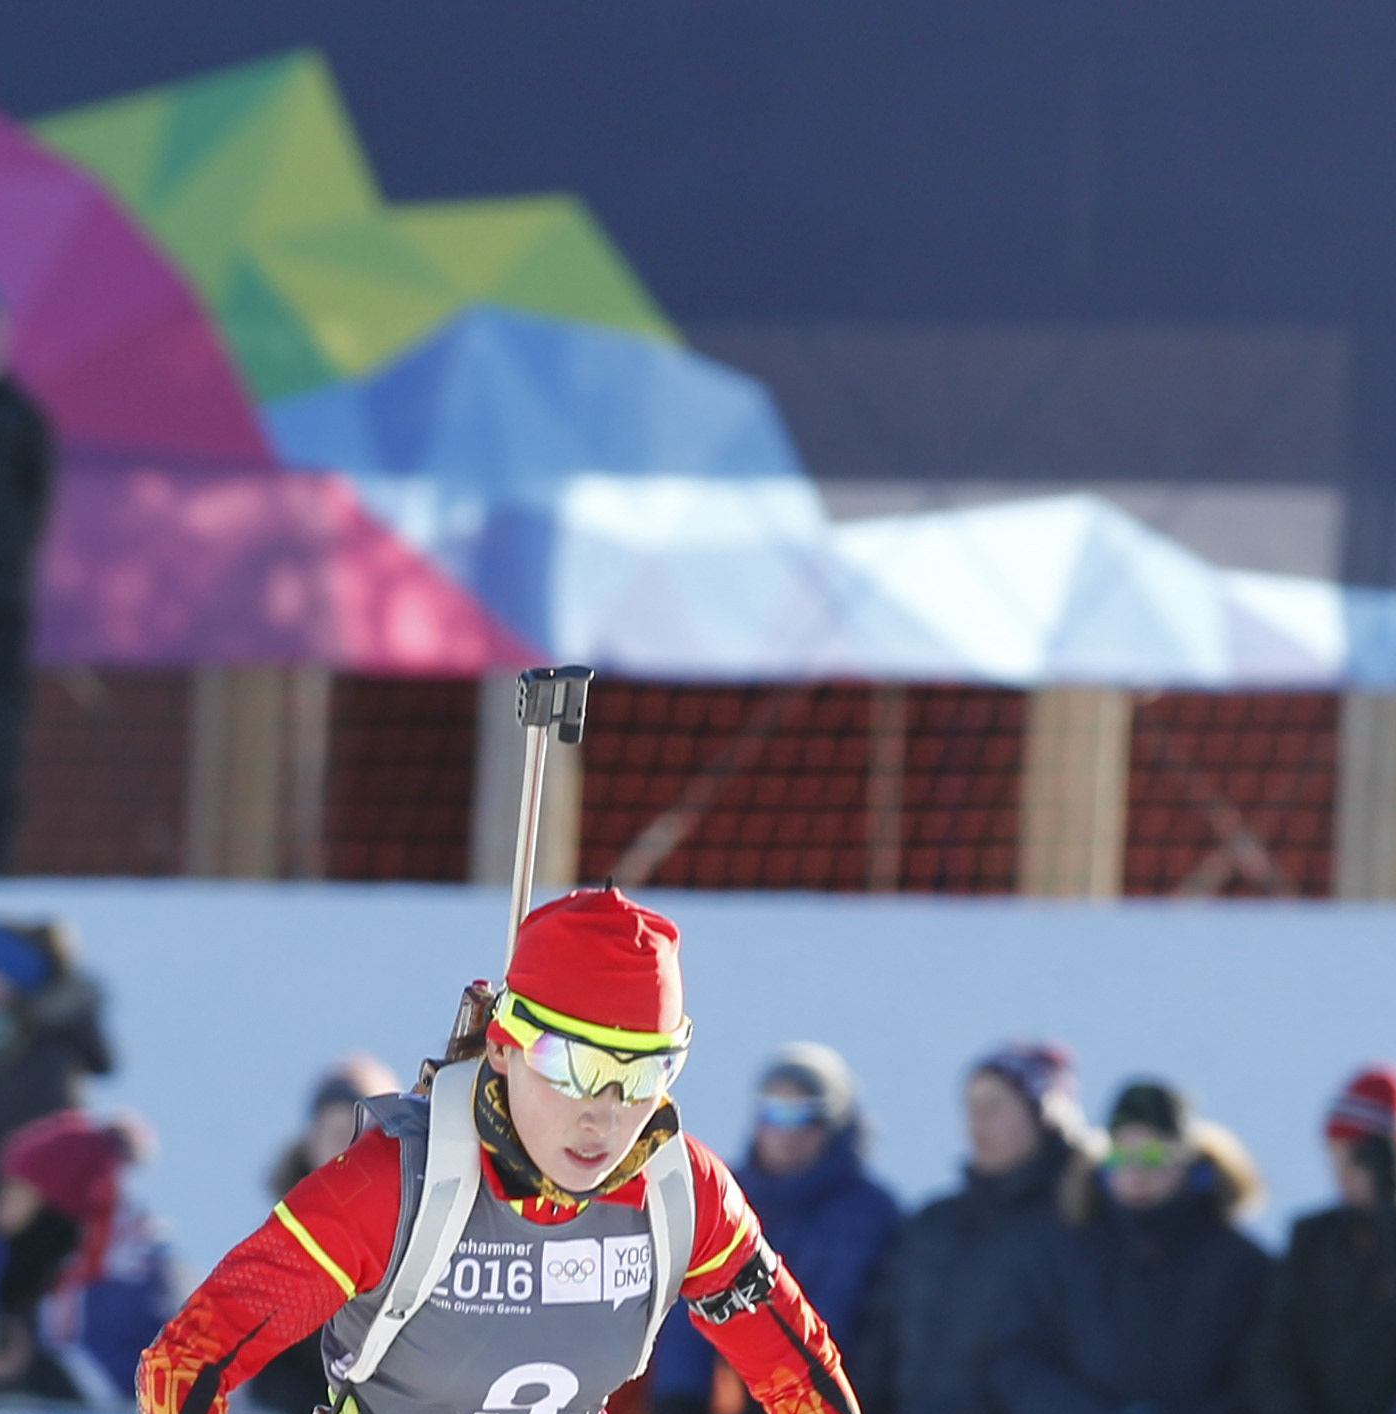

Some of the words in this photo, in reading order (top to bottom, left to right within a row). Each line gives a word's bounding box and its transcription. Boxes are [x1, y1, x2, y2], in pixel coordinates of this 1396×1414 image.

[456, 1238, 534, 1257] ehammer
[614, 1246, 650, 1266] YOG
[614, 1267, 648, 1289] DNA
[429, 1298, 452, 1310] uth
[454, 1301, 495, 1316] Olympic
[497, 1303, 532, 1315] Games
